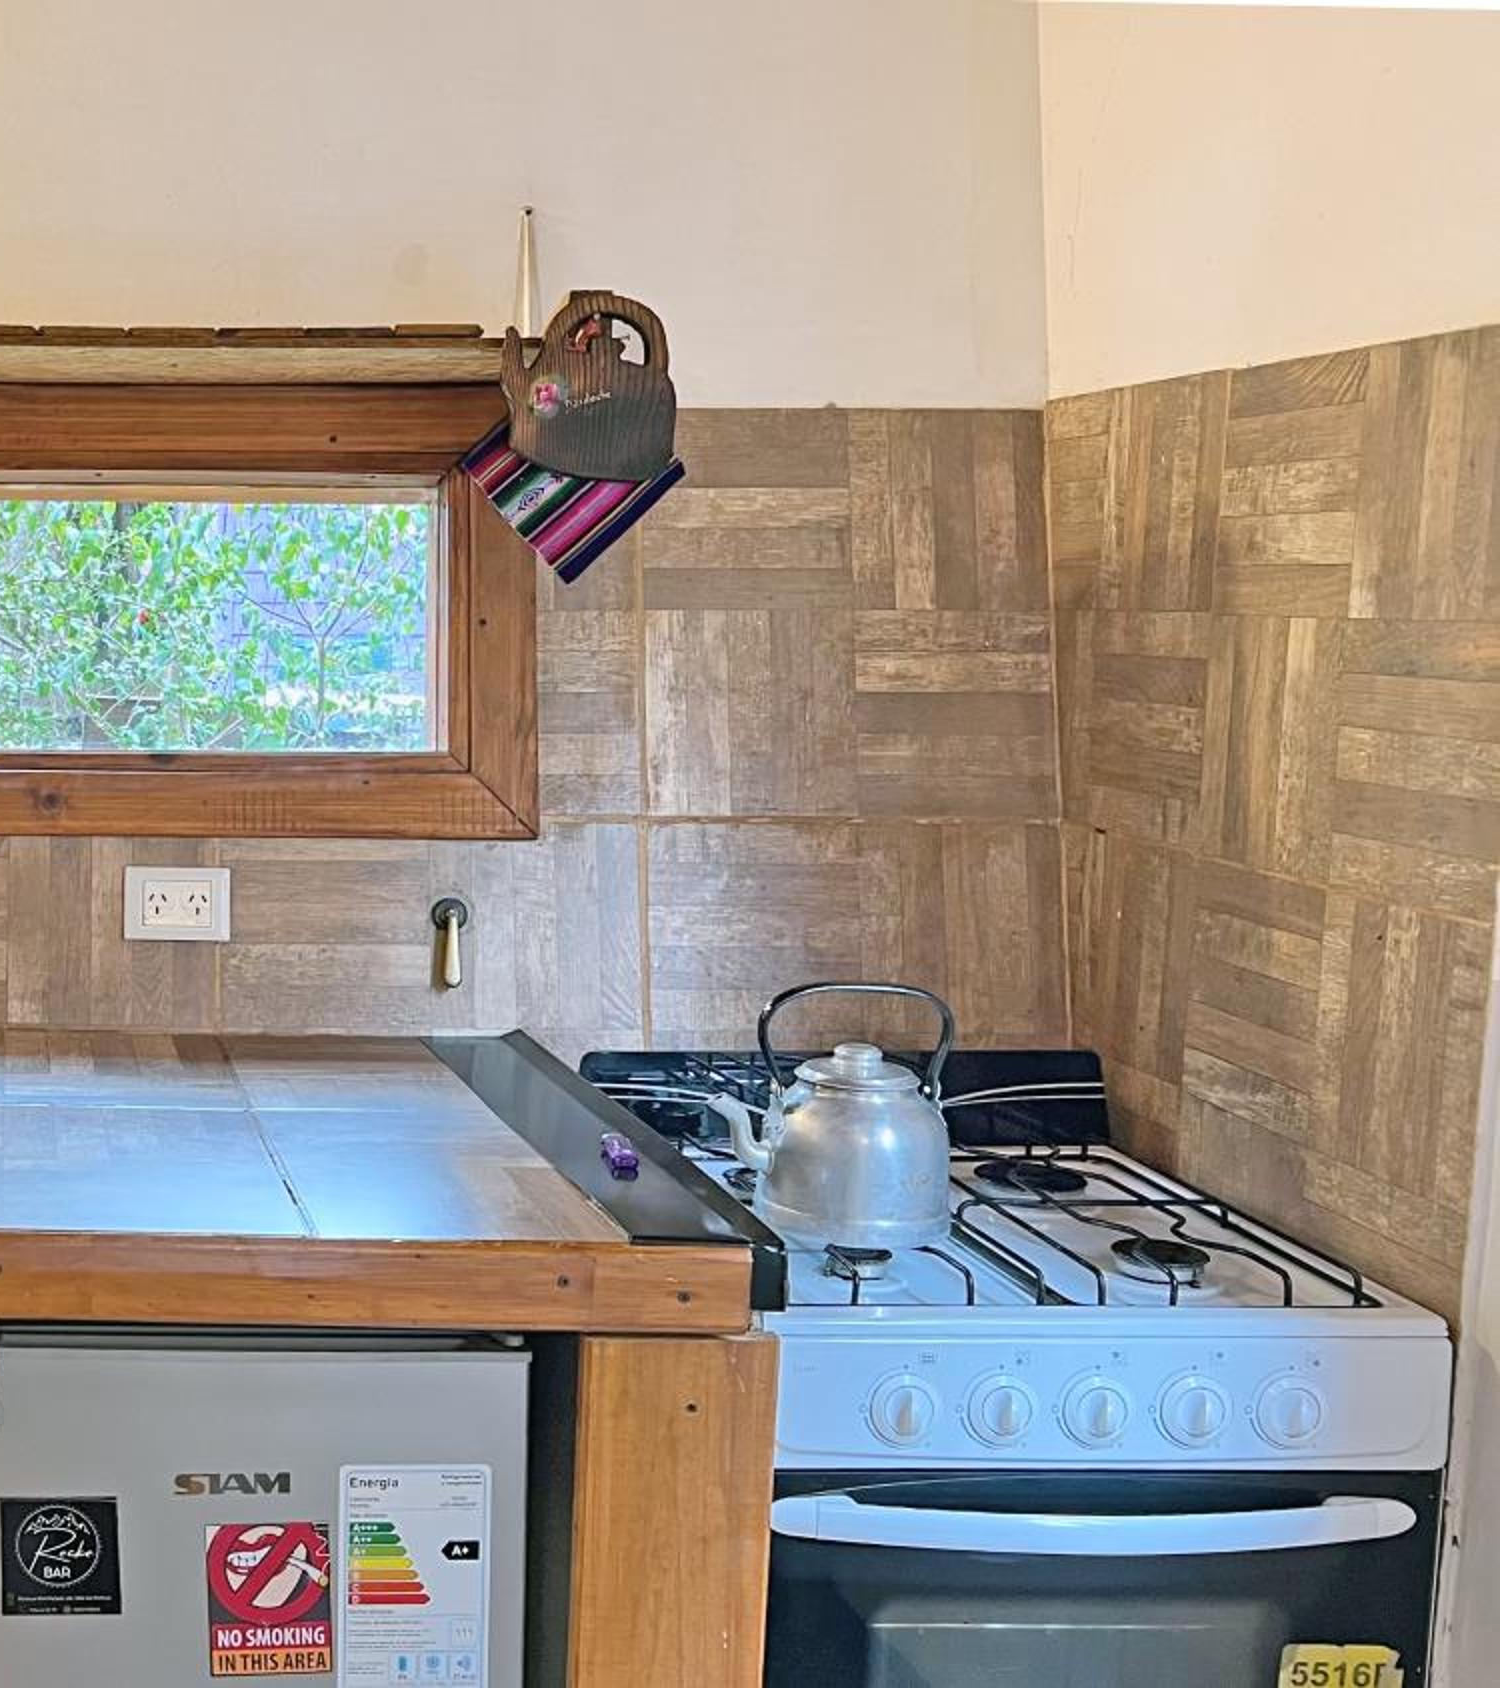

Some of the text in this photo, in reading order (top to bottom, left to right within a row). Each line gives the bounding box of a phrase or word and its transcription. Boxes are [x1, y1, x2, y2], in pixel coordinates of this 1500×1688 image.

[173, 1472, 291, 1495] SIAM
[450, 1544, 470, 1557] A+
[43, 1565, 72, 1579] BAR
[217, 1629, 243, 1648] NO
[246, 1626, 326, 1647] SMOKING
[218, 1655, 237, 1673] IN
[240, 1653, 279, 1671] THIS
[283, 1651, 328, 1669] AREA
